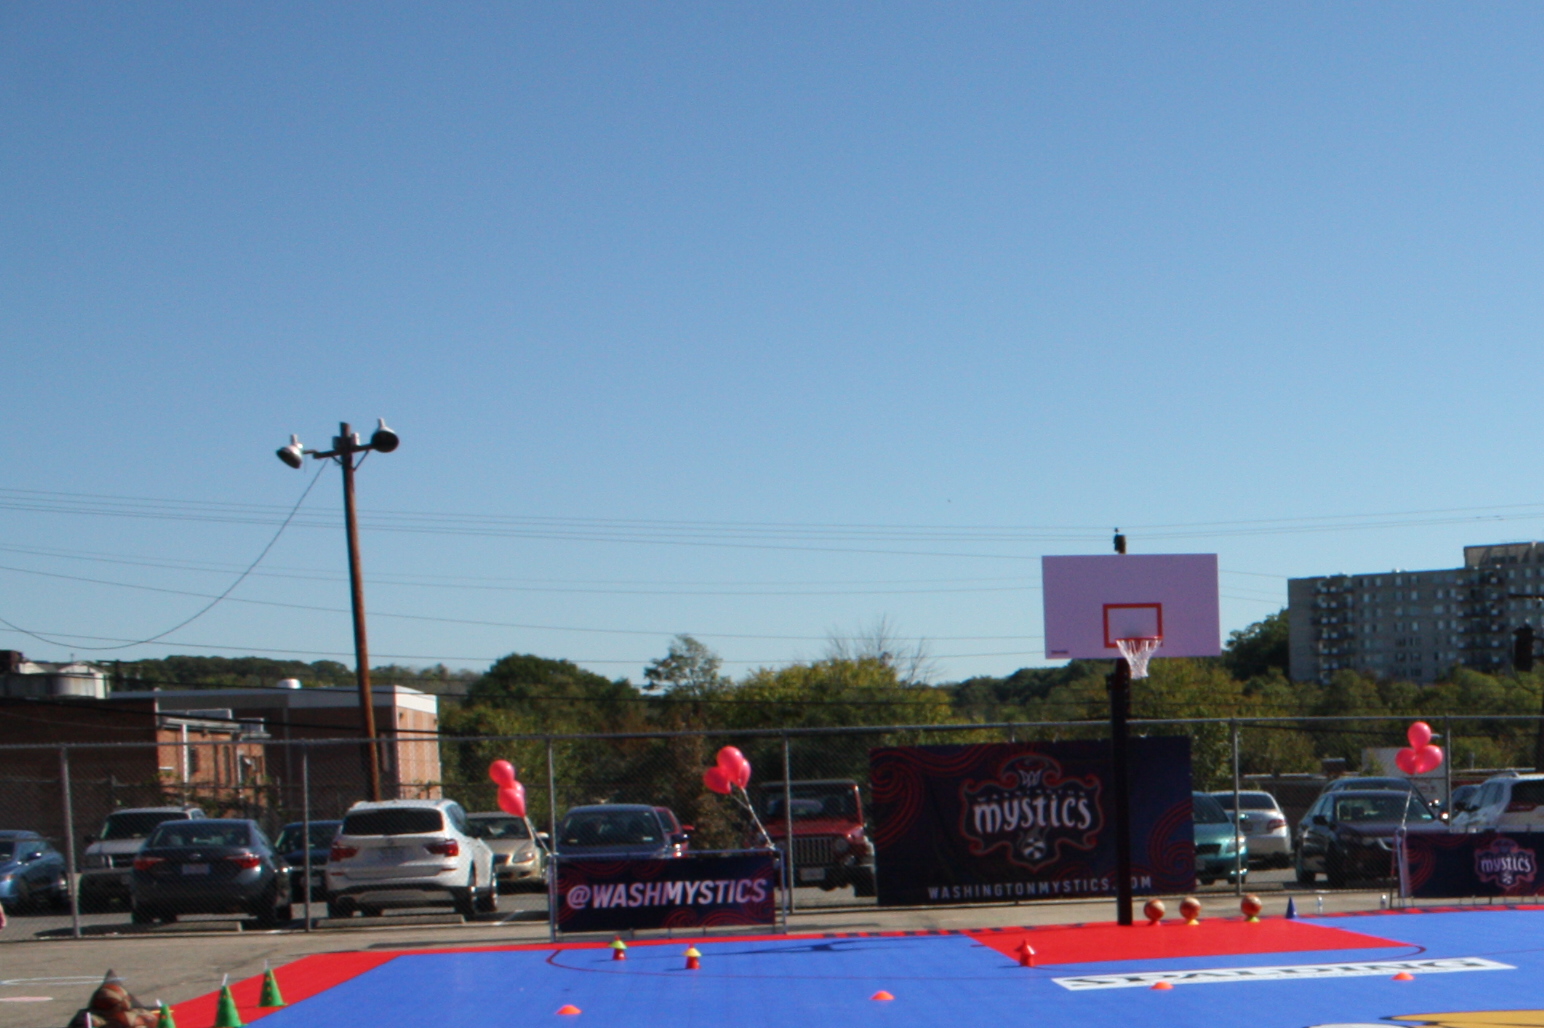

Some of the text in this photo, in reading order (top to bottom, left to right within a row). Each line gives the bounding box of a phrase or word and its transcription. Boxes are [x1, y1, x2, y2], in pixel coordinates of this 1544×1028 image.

[972, 793, 1092, 835] mystics
[566, 879, 768, 910] @WASHMYSTICS
[927, 876, 1152, 900] WASHINGTONMYSTICS.OM
